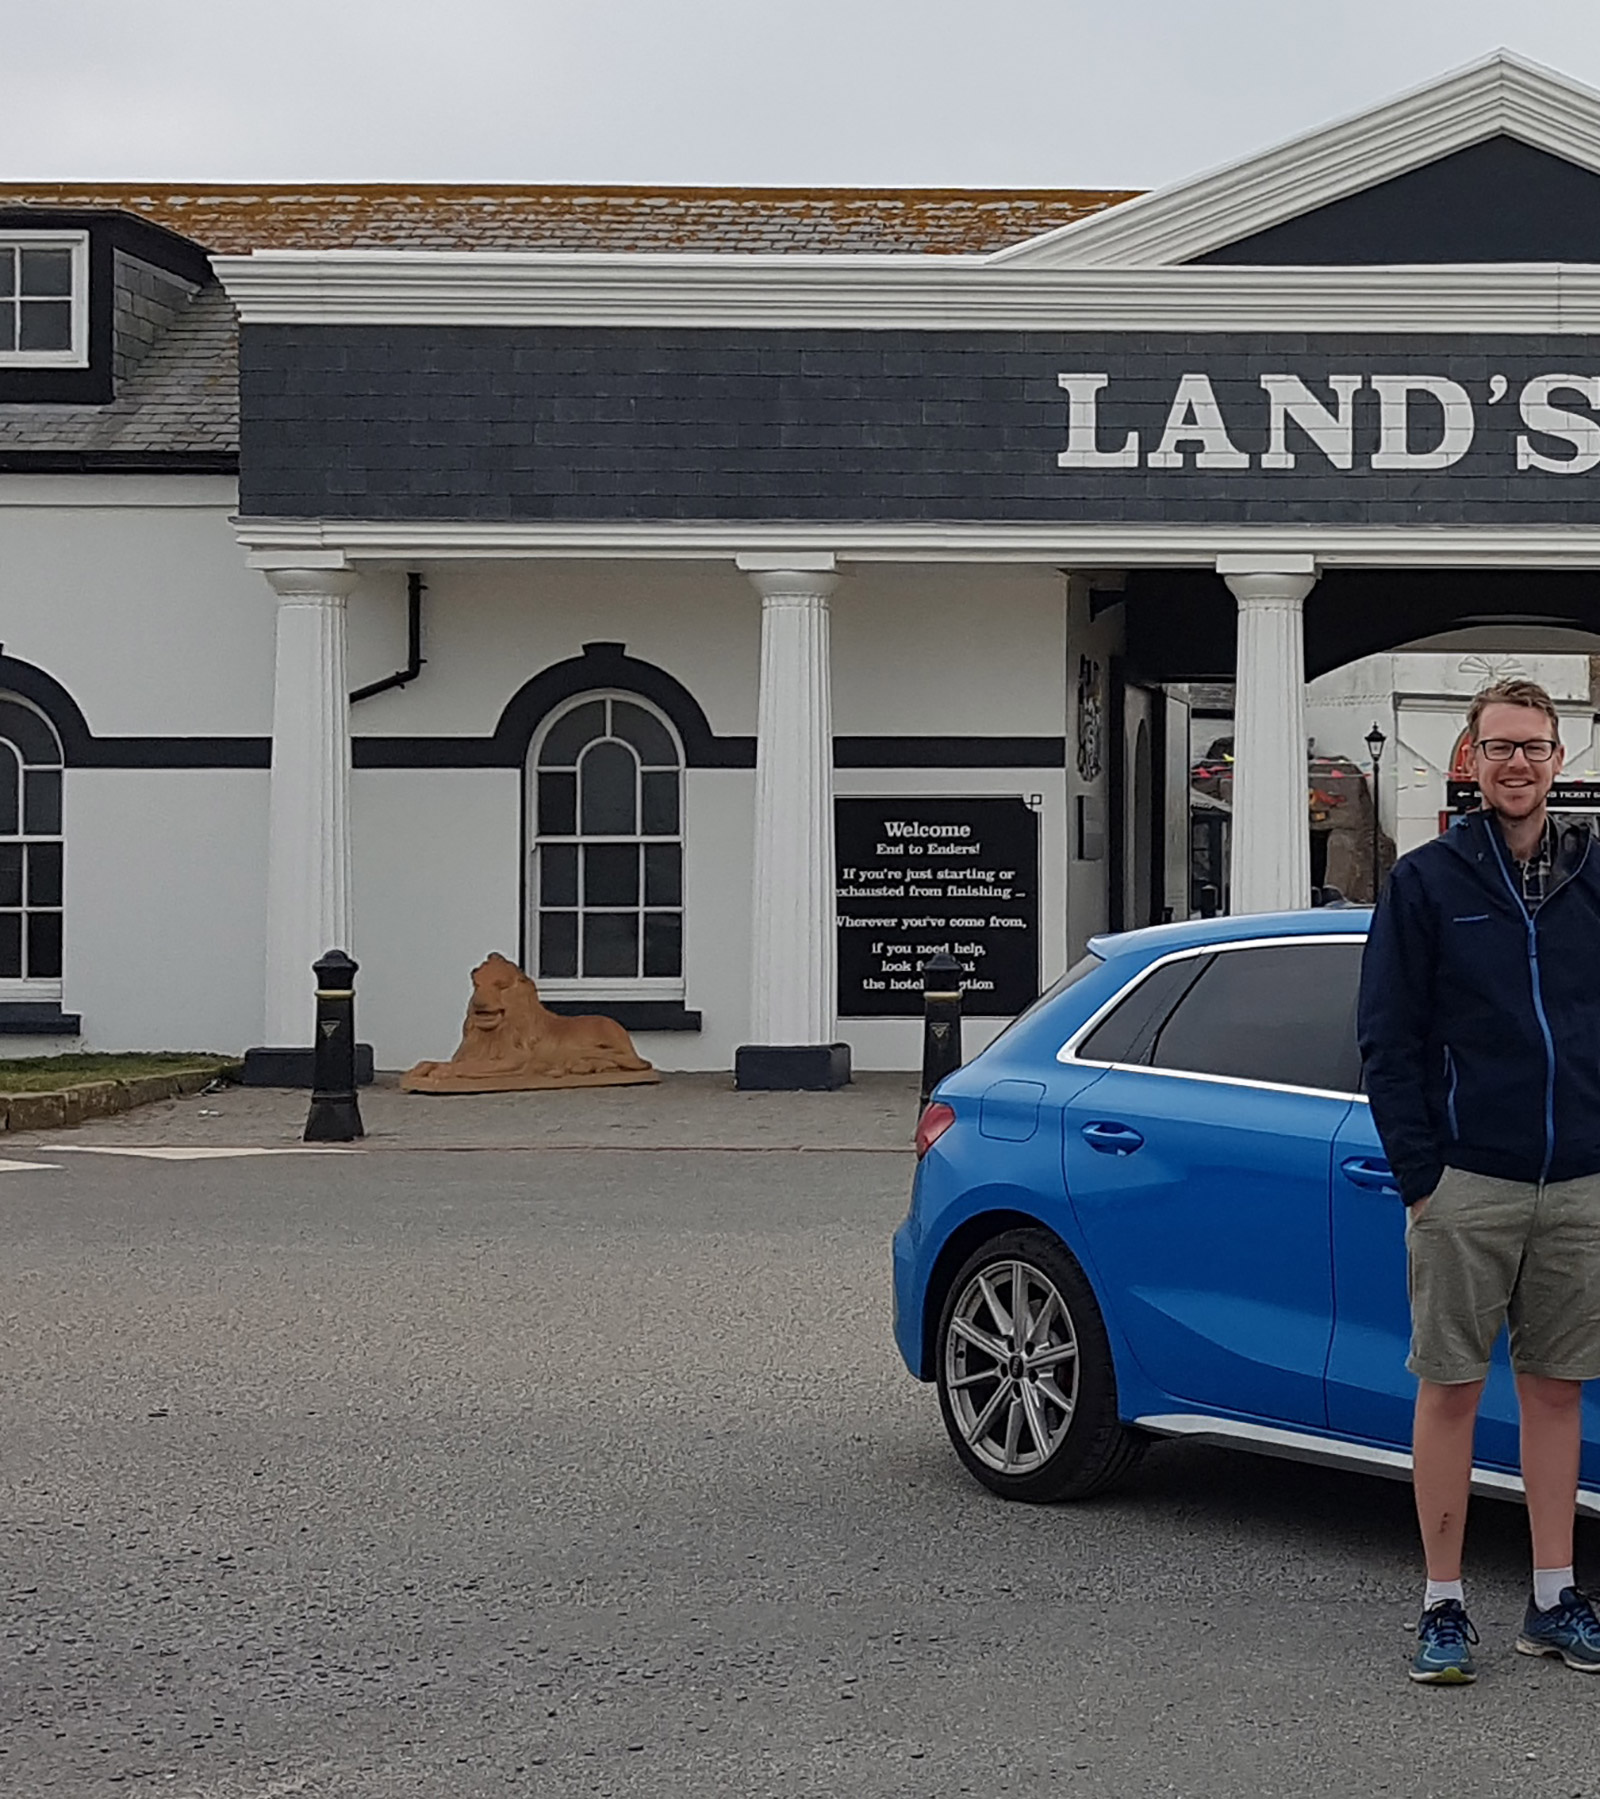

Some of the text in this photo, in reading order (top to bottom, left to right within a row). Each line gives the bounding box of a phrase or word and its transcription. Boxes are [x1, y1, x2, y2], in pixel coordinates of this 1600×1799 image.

[883, 821, 971, 837] Welcome
[876, 842, 981, 855] End to Enders!
[842, 867, 1016, 883] If you're just starting or
[908, 885, 943, 897] from
[946, 885, 1013, 899] finishing
[900, 916, 946, 929] you've
[949, 918, 986, 928] come
[989, 915, 1028, 929] from,
[871, 942, 987, 957] if you need help,
[881, 960, 912, 972] look
[862, 978, 886, 990] the
[889, 978, 925, 990] hotel
